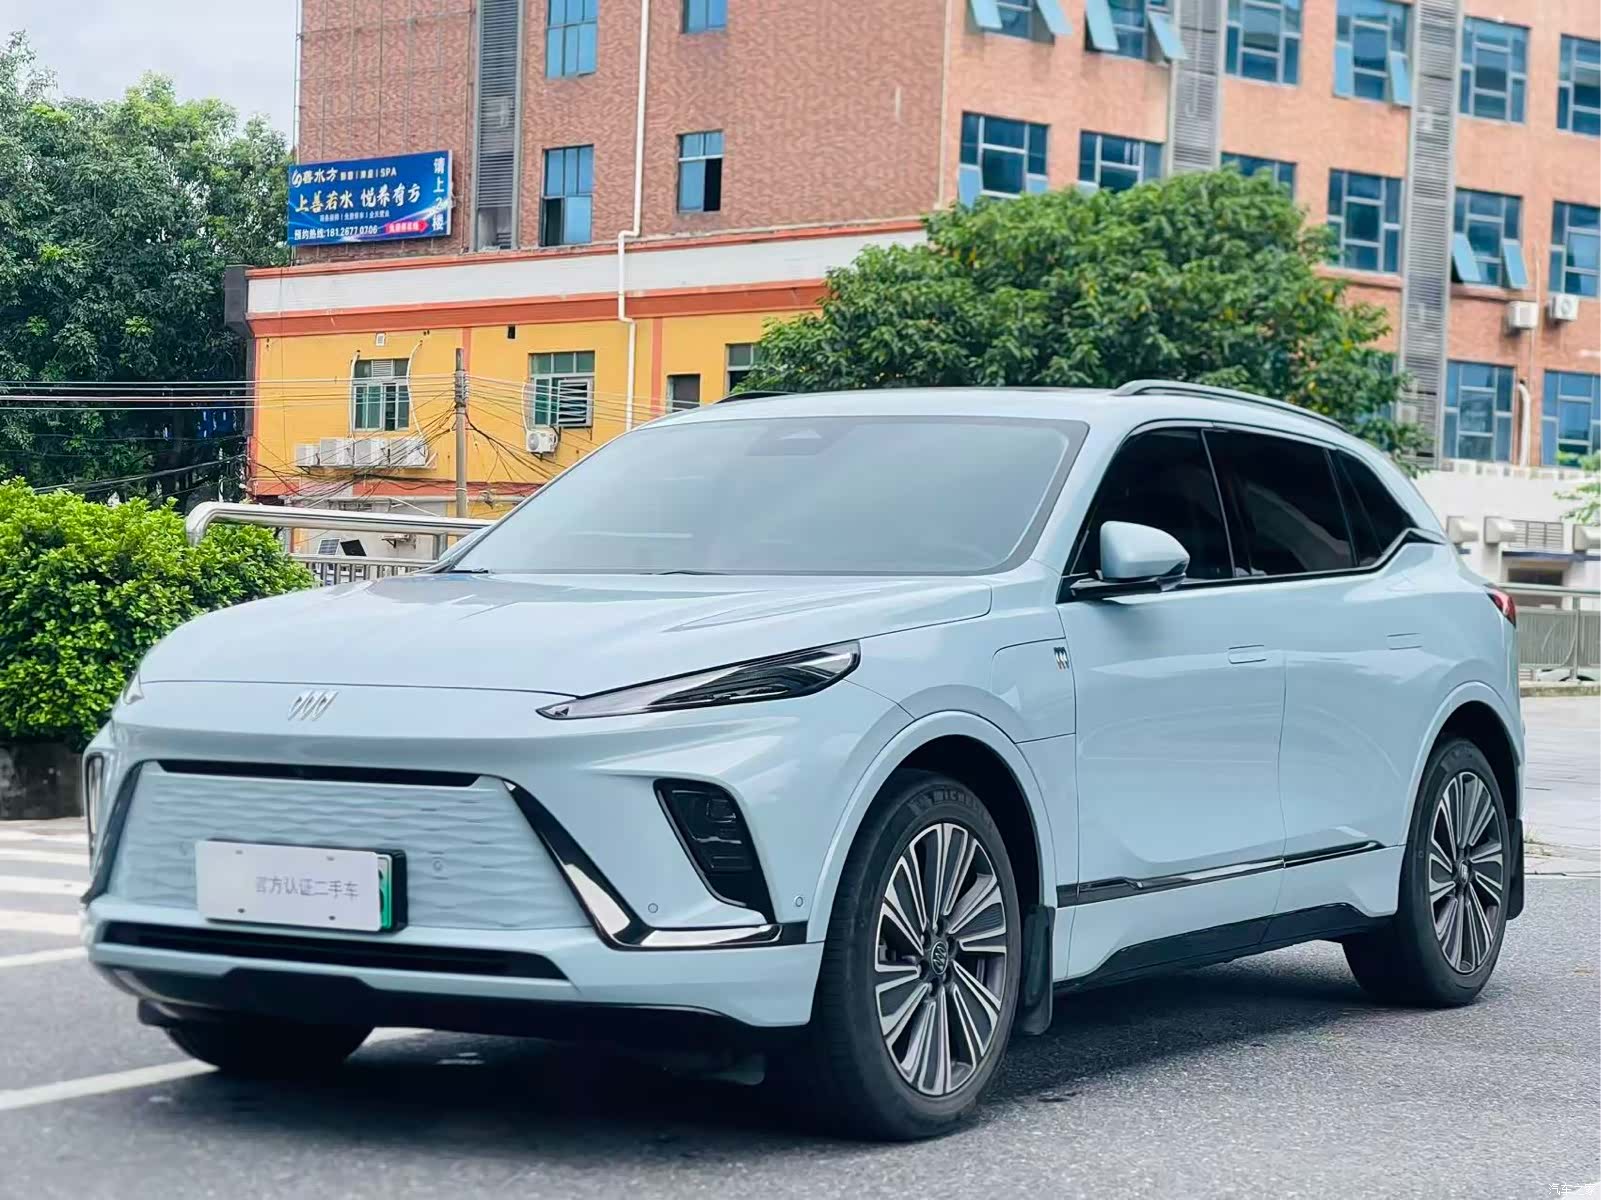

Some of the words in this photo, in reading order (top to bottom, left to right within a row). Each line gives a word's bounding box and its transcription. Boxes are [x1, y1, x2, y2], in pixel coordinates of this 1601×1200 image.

[380, 167, 397, 177] SPA
[295, 190, 354, 213] 上善若水
